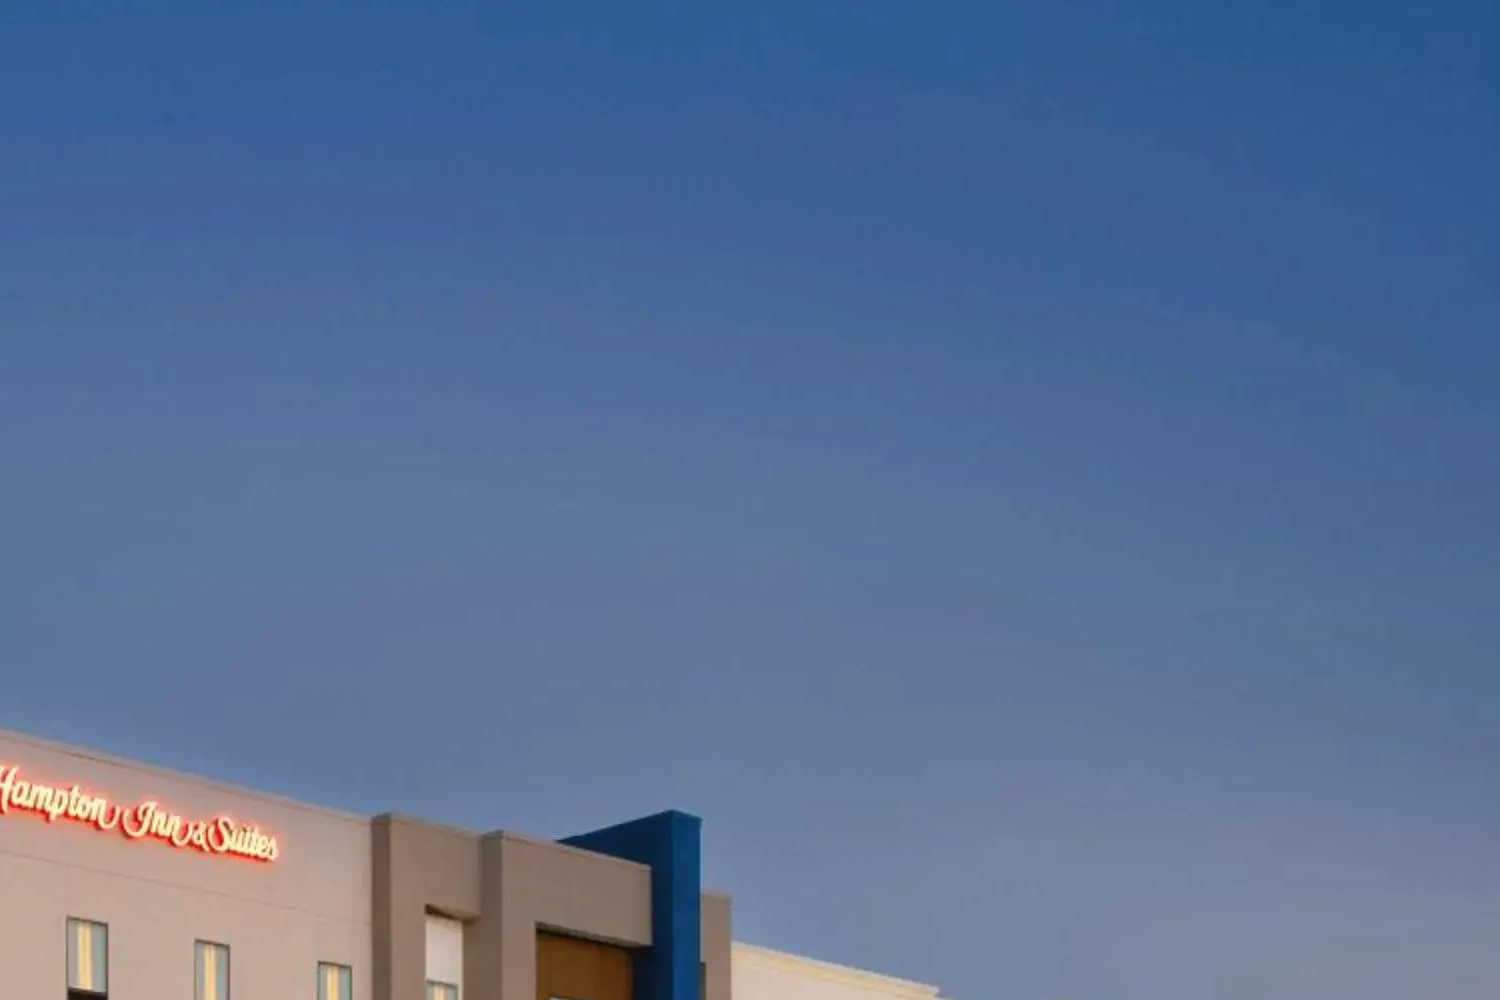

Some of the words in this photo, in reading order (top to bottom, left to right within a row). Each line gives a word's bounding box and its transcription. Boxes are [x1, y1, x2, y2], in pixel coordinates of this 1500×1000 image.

[122, 801, 193, 846] Inn
[193, 822, 208, 851] &
[207, 816, 278, 861] Suites
